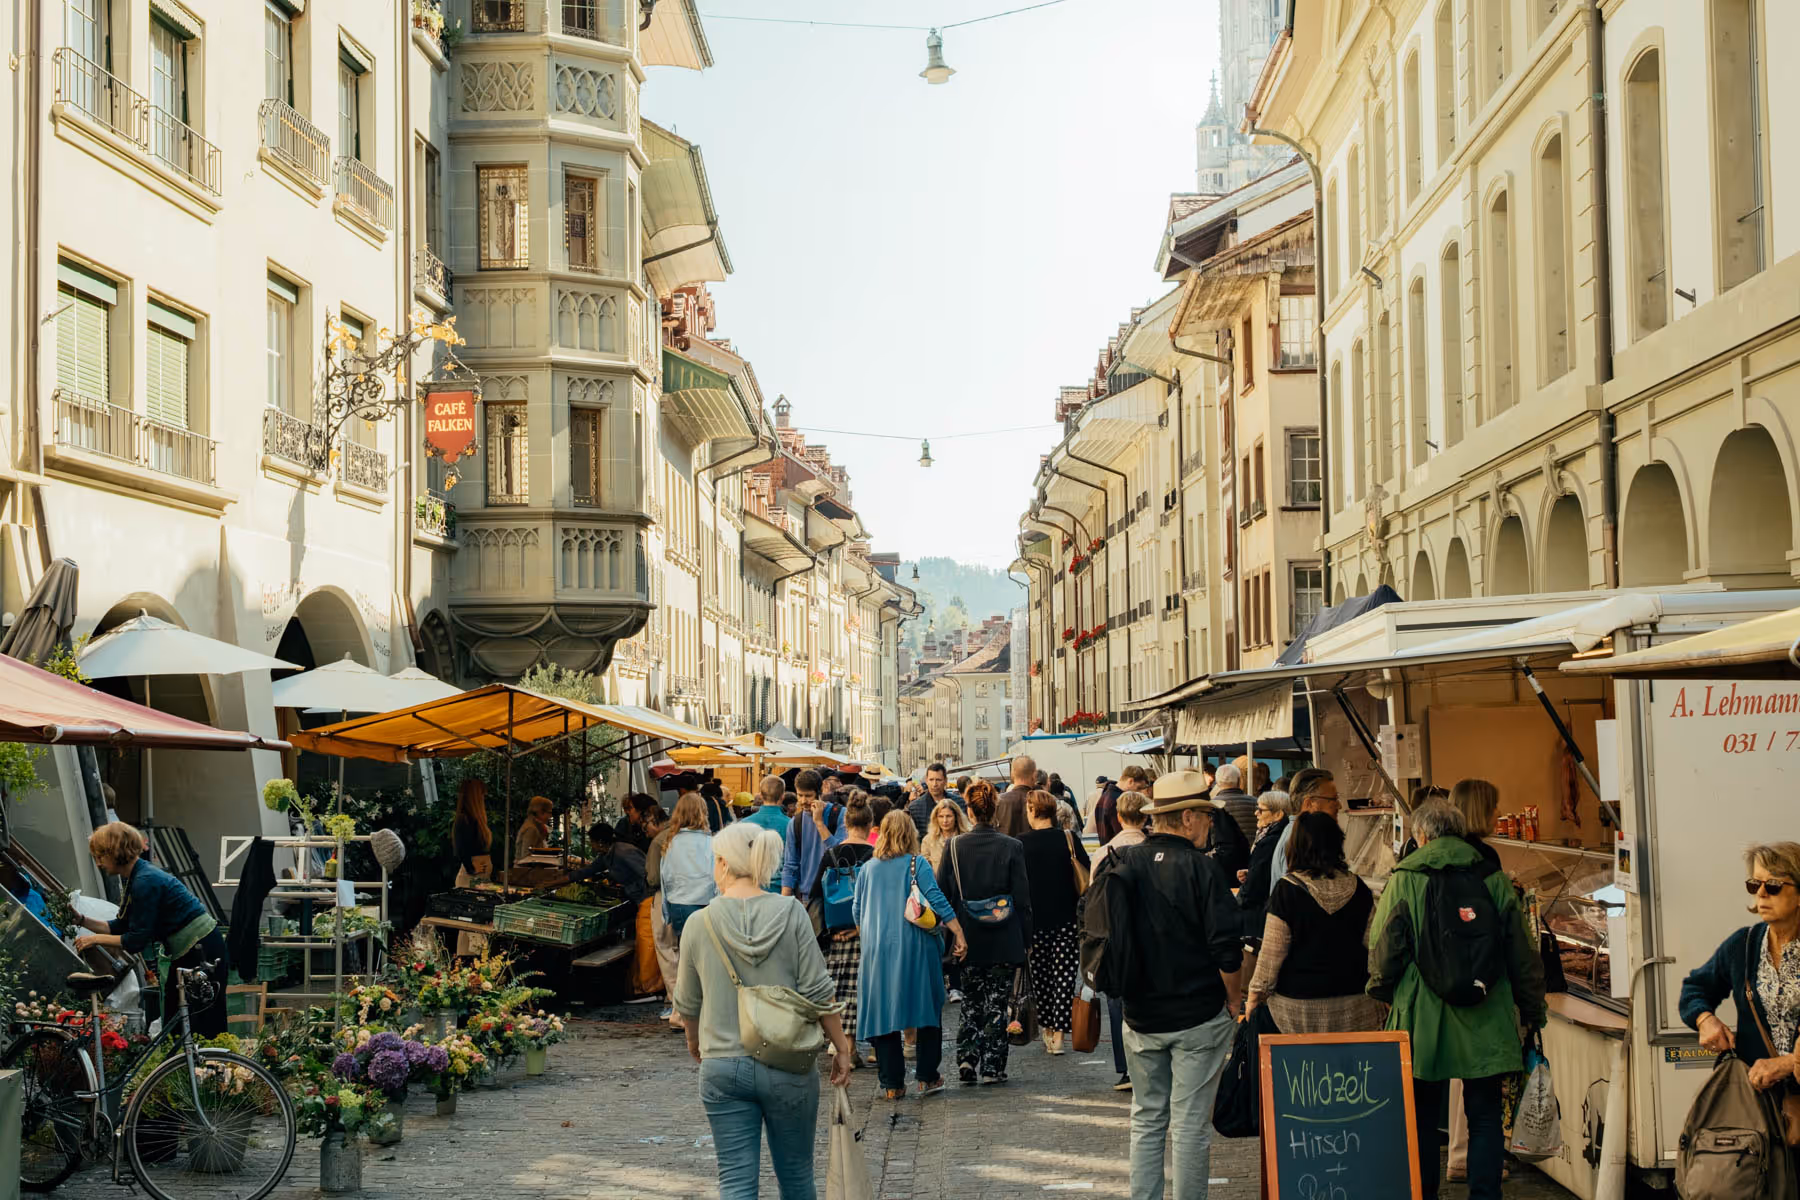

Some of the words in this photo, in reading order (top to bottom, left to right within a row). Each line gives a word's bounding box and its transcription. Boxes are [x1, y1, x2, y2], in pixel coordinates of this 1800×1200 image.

[434, 400, 466, 416] CAFÉ
[428, 418, 472, 432] FALKEN
[1669, 686, 1694, 718] A.
[1723, 732, 1758, 754] 031
[1786, 730, 1800, 752] 7
[1282, 1058, 1379, 1108] Wildzeit
[1289, 1128, 1360, 1160] Hirsch
